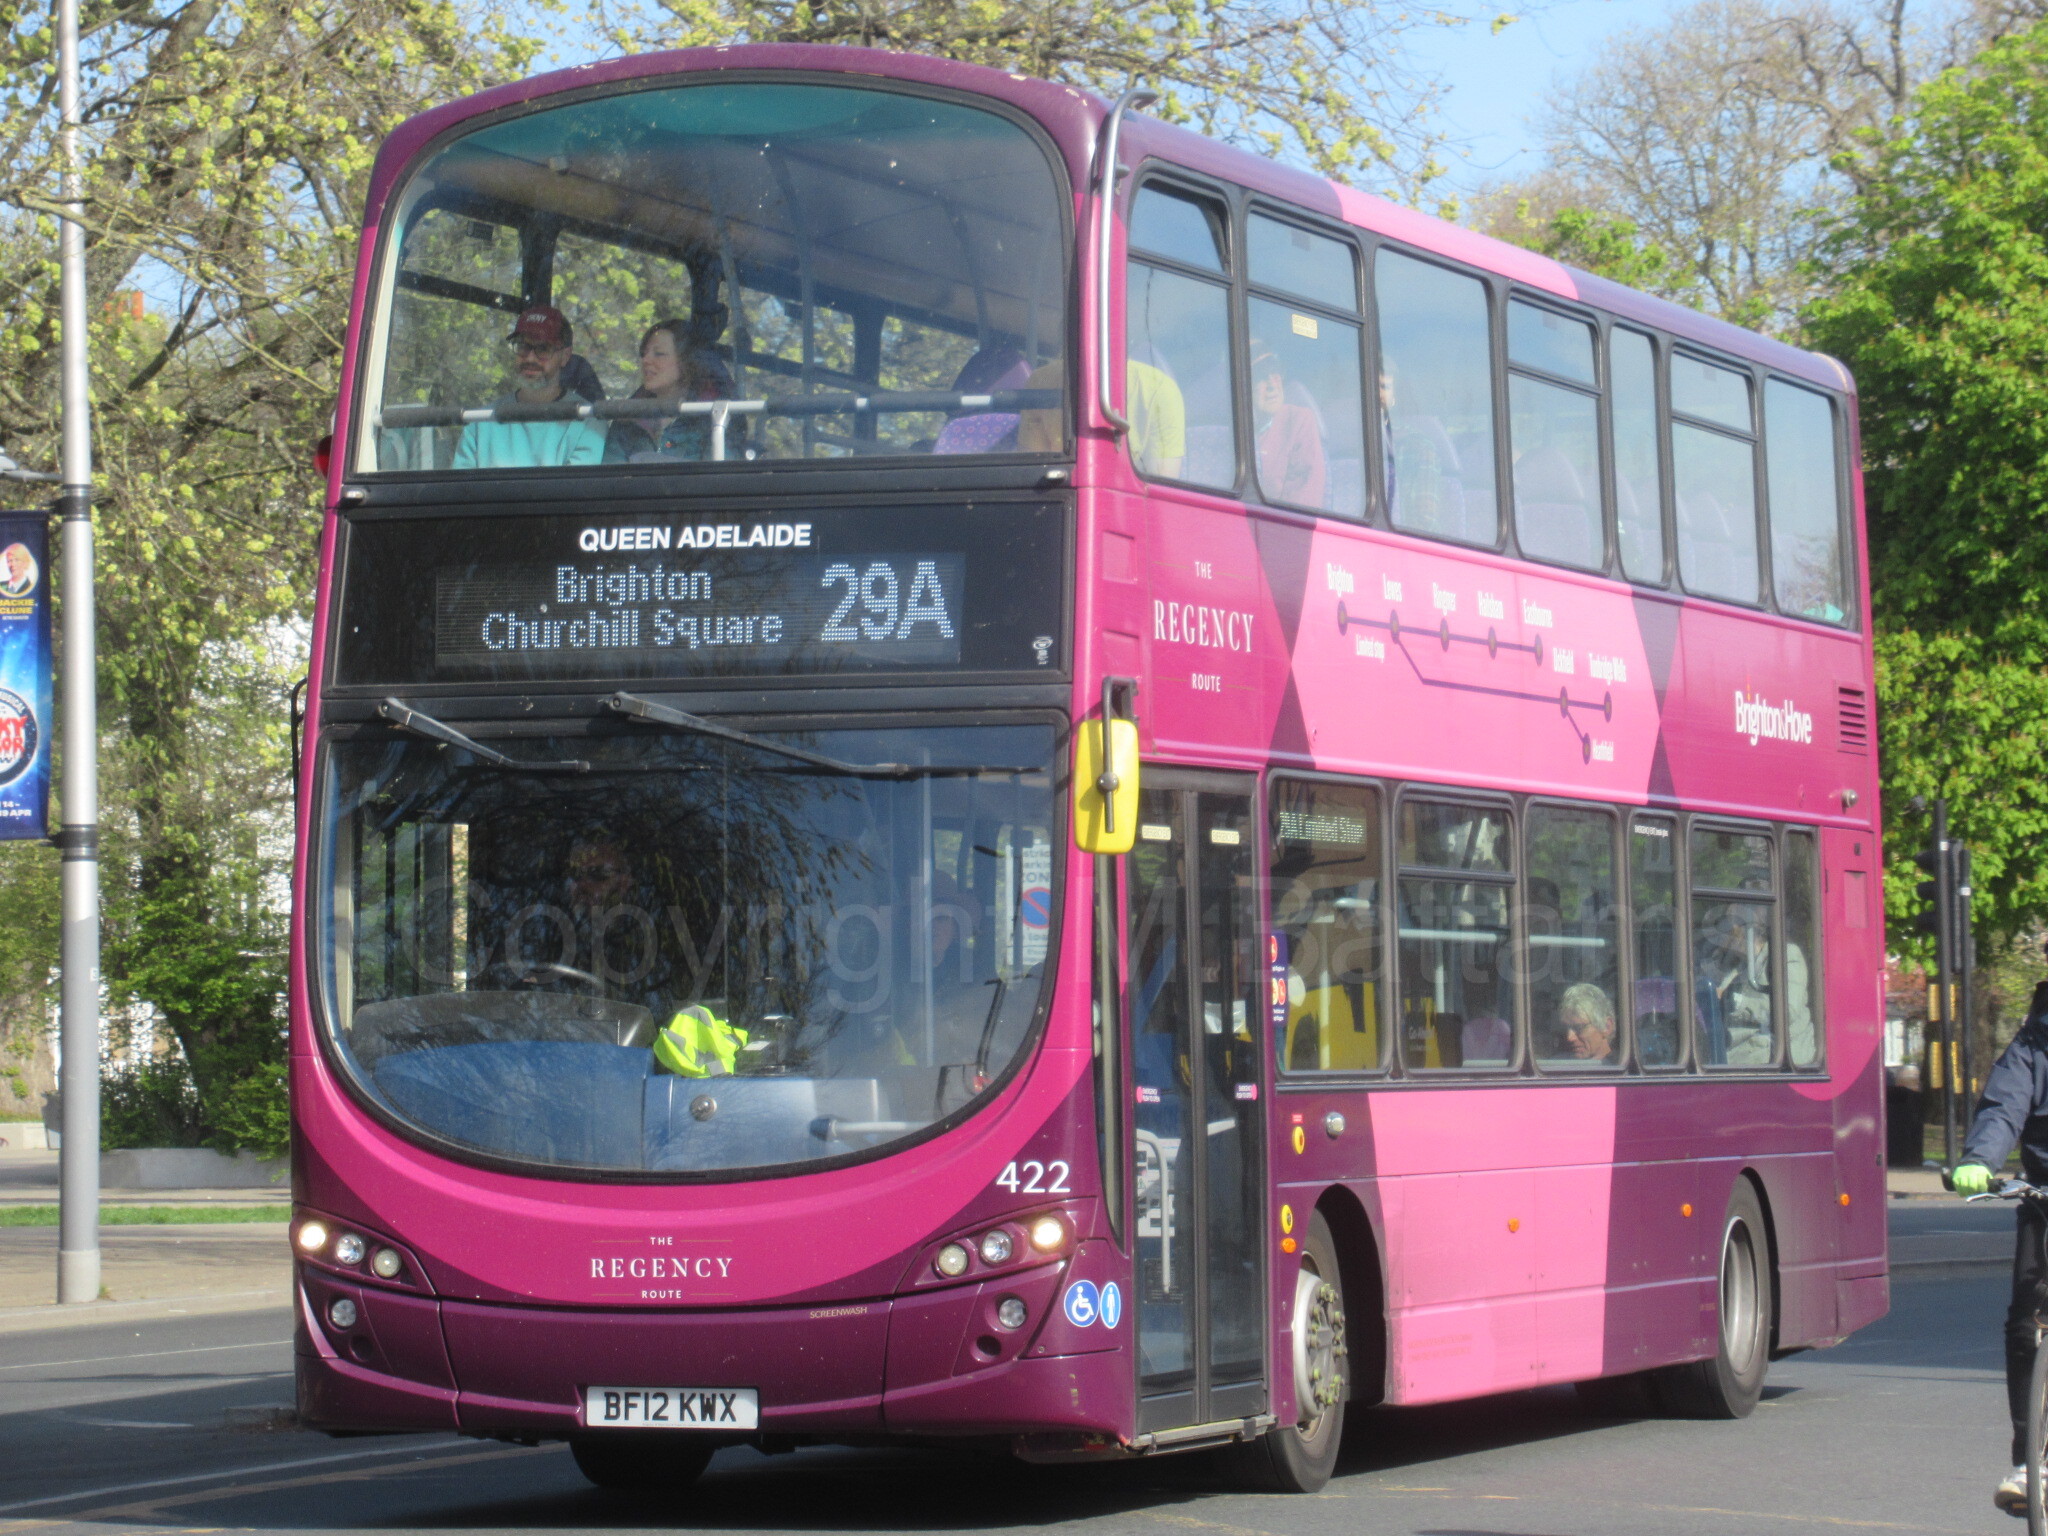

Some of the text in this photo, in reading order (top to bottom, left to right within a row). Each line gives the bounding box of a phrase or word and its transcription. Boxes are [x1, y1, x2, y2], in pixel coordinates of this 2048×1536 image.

[579, 524, 811, 552] QUEEN ADELAIDE
[1195, 561, 1213, 579] THE
[557, 565, 712, 606] Brighton
[821, 561, 954, 642] 29A
[481, 609, 783, 649] Churchill Square
[1154, 600, 1254, 652] REGENCY
[1192, 673, 1221, 692] ROUTE
[996, 1161, 1071, 1193] 422
[650, 1237, 673, 1245] THE
[591, 1258, 733, 1278] REGENCY
[641, 1290, 682, 1299] ROUTE
[810, 1306, 868, 1319] SCREENWASH
[604, 1391, 737, 1422] BF12 KWX
